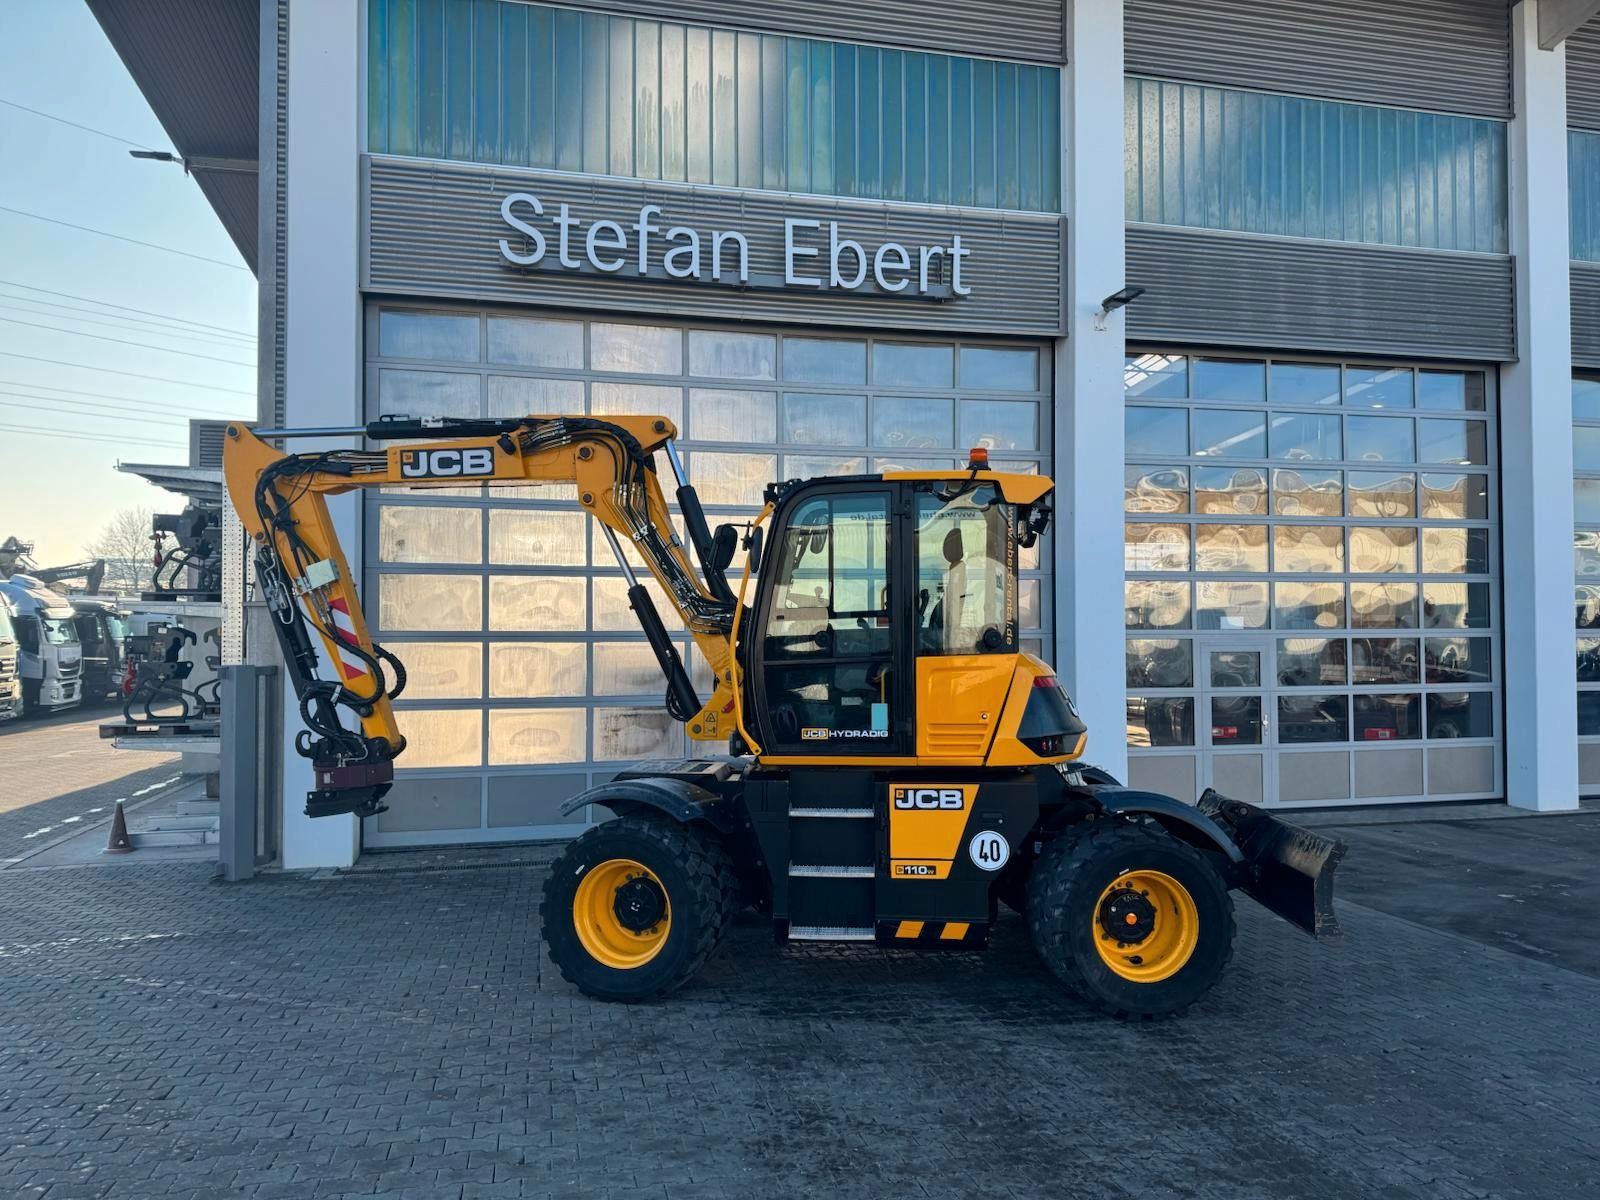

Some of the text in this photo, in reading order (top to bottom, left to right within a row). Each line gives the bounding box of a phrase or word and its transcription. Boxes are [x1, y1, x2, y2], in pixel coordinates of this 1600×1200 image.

[498, 192, 971, 296] Stefan Ebert
[403, 449, 493, 476] JCB
[1006, 506, 1015, 646] www.ebert-rental.de
[803, 729, 827, 738] JCB
[895, 789, 963, 809] JCB
[979, 839, 1001, 862] 40
